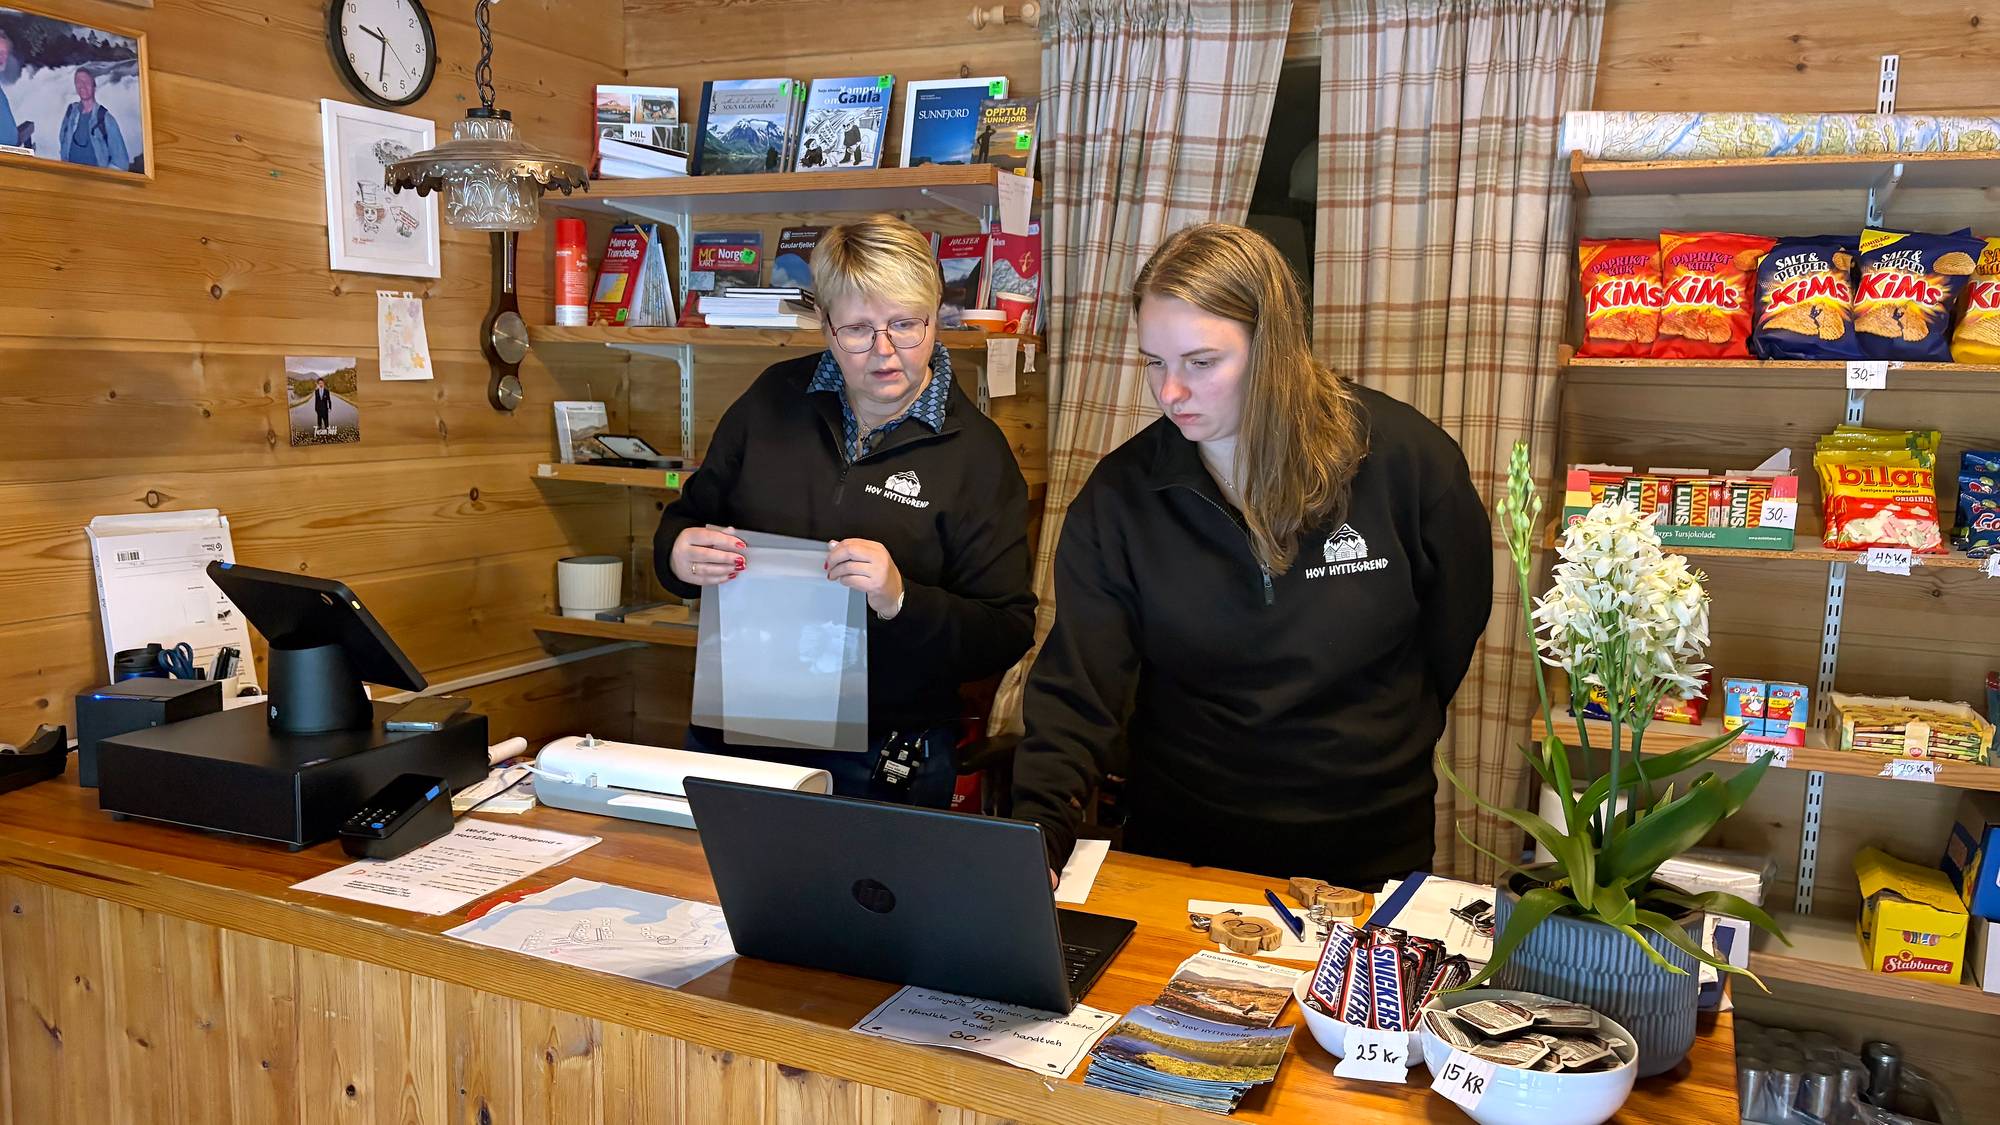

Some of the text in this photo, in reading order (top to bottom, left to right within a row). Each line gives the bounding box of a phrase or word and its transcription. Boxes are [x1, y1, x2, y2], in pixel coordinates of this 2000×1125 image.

[346, 3, 357, 14] 10
[408, 18, 415, 28] 2
[341, 26, 348, 36] 9
[415, 43, 421, 53] 3
[349, 52, 356, 63] 8
[364, 72, 370, 82] 7
[411, 67, 417, 76] 4
[382, 82, 388, 92] 6
[399, 80, 406, 90] 5
[838, 91, 881, 104] Gaula
[918, 108, 970, 120] SUNNFJORD
[985, 107, 1027, 117] OPPTUR
[983, 116, 1027, 124] SUNNFJORD
[630, 130, 646, 139] MIL
[609, 238, 637, 249] Møre og
[780, 241, 815, 250] Gaularfjellet
[949, 237, 979, 246] JØLSTER
[607, 248, 639, 259] Trøndelag
[699, 249, 716, 260] MC
[1881, 250, 1922, 263] SALT &
[1775, 252, 1820, 270] SALT &
[1873, 257, 1925, 275] PEPPER
[1774, 261, 1829, 282] PEPPER
[1661, 275, 1742, 310] KiMs
[1766, 275, 1852, 313] KiMs
[1854, 272, 1943, 307] KiMs
[1588, 280, 1663, 316] KiMs
[1851, 367, 1876, 381] 30,-
[1835, 464, 1933, 489] bilar
[865, 484, 930, 509] HOV HYTTEGREND
[1765, 507, 1788, 523] 30,-
[1675, 530, 1716, 540] Tursjokolade
[1305, 557, 1389, 580] HOV HYTTEGREND
[1223, 919, 1263, 934] 3
[1885, 957, 1949, 973] Stabburet
[1373, 947, 1401, 1032] SNICKERS
[962, 1018, 993, 1032] towel
[949, 1030, 991, 1043] 30,-
[1356, 1044, 1378, 1061] 25
[1443, 1063, 1484, 1094] 15 KR
